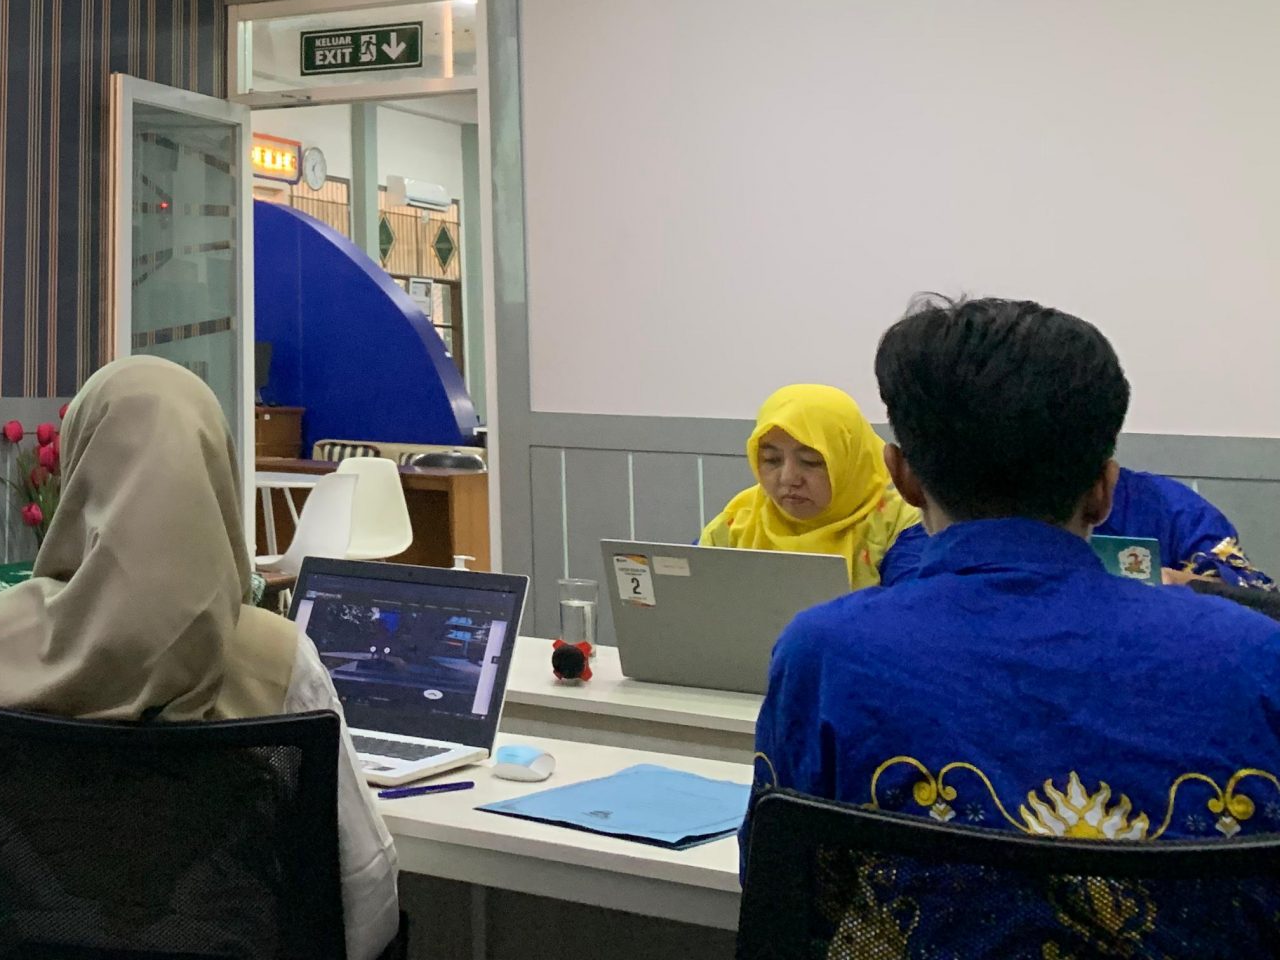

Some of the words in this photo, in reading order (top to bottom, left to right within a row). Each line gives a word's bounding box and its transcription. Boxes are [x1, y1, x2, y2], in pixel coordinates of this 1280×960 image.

[315, 36, 352, 47] KELUAR
[315, 49, 353, 65] EXIT
[631, 576, 642, 596] 2
